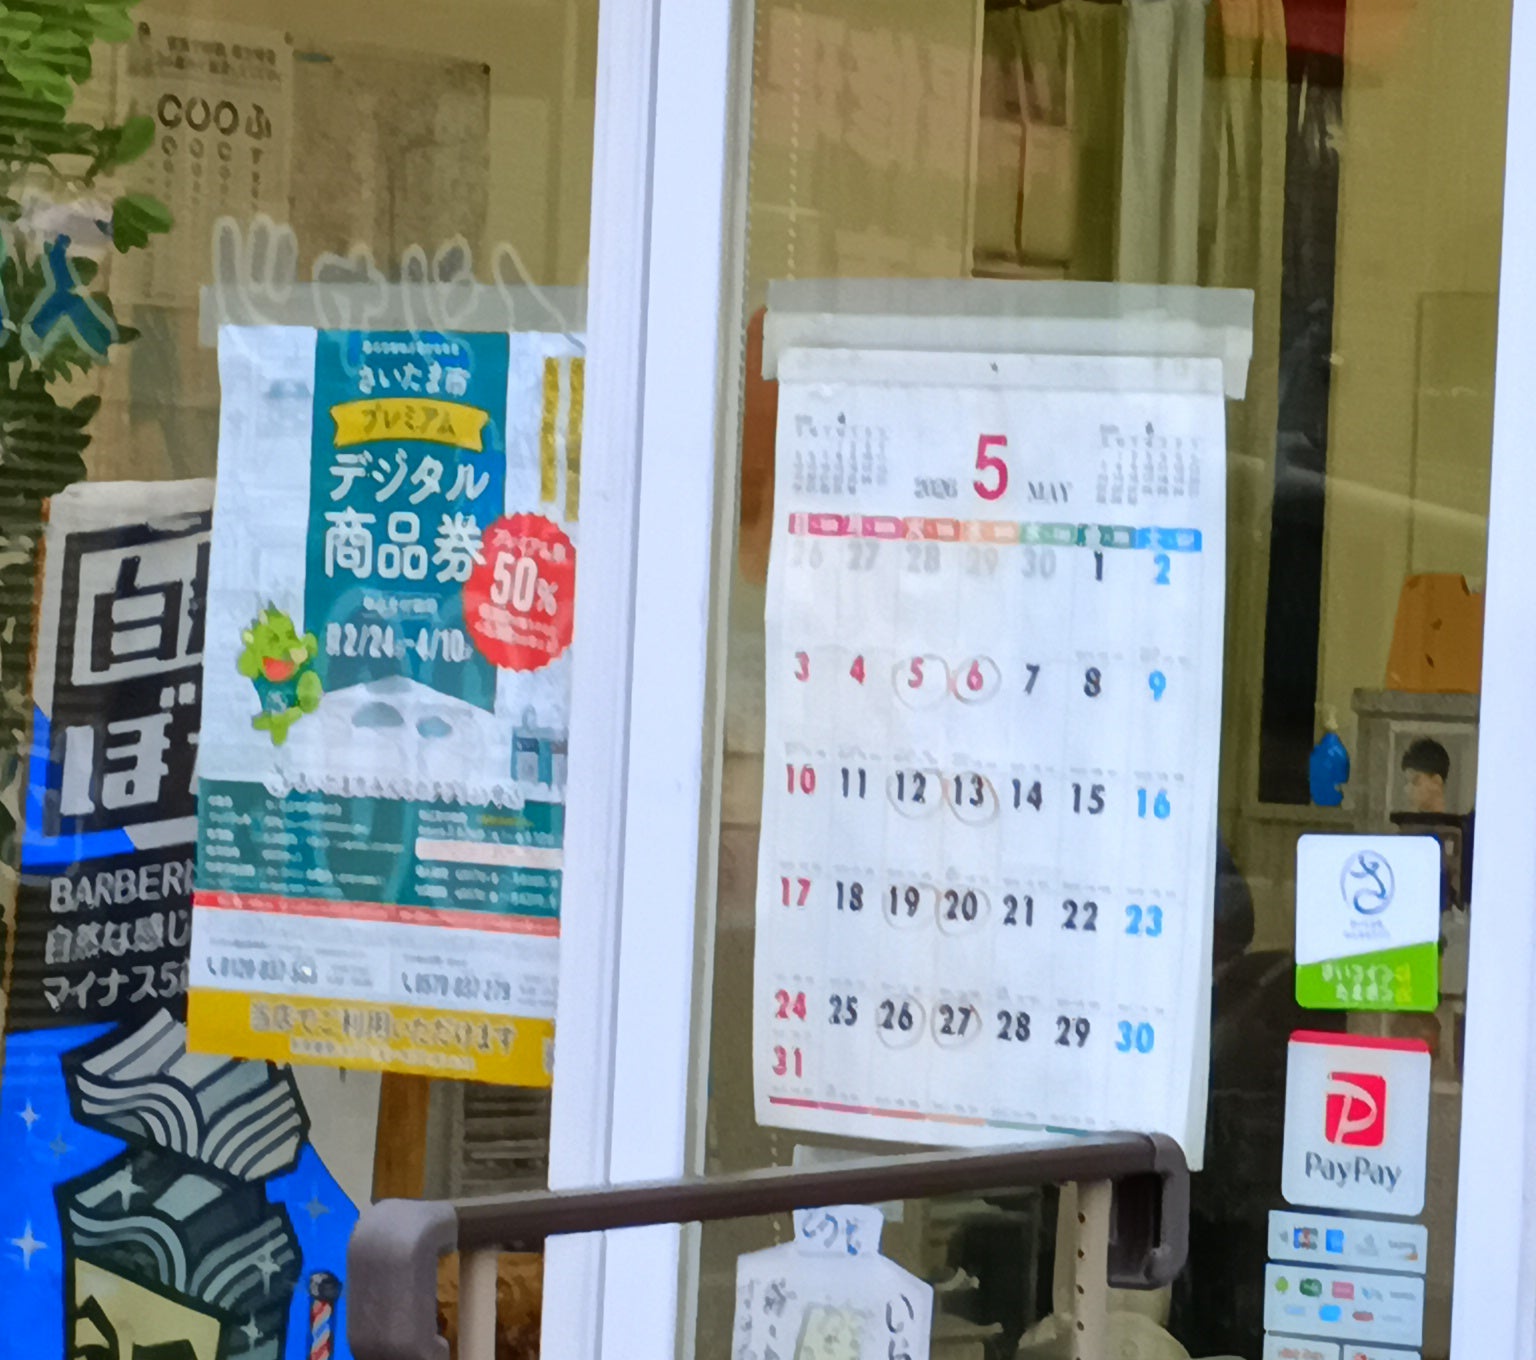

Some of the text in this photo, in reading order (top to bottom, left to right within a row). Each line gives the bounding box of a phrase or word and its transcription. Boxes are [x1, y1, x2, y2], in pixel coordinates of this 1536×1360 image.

[361, 403, 456, 437] プレミアム
[329, 447, 490, 505] デジタル
[973, 433, 1009, 501] 5
[324, 506, 487, 583] 商品券
[1154, 554, 1171, 585] 2
[794, 652, 1166, 701] 3 4 5 6 7 8 9
[786, 764, 1171, 819] 10 11 12 13 14 15 16
[780, 877, 1163, 937] 17 18 19 20 21 22 23
[774, 990, 1155, 1054] 24 25 26 27 28 29 30
[772, 1046, 802, 1078] 31
[1305, 1151, 1402, 1193] PayPay
